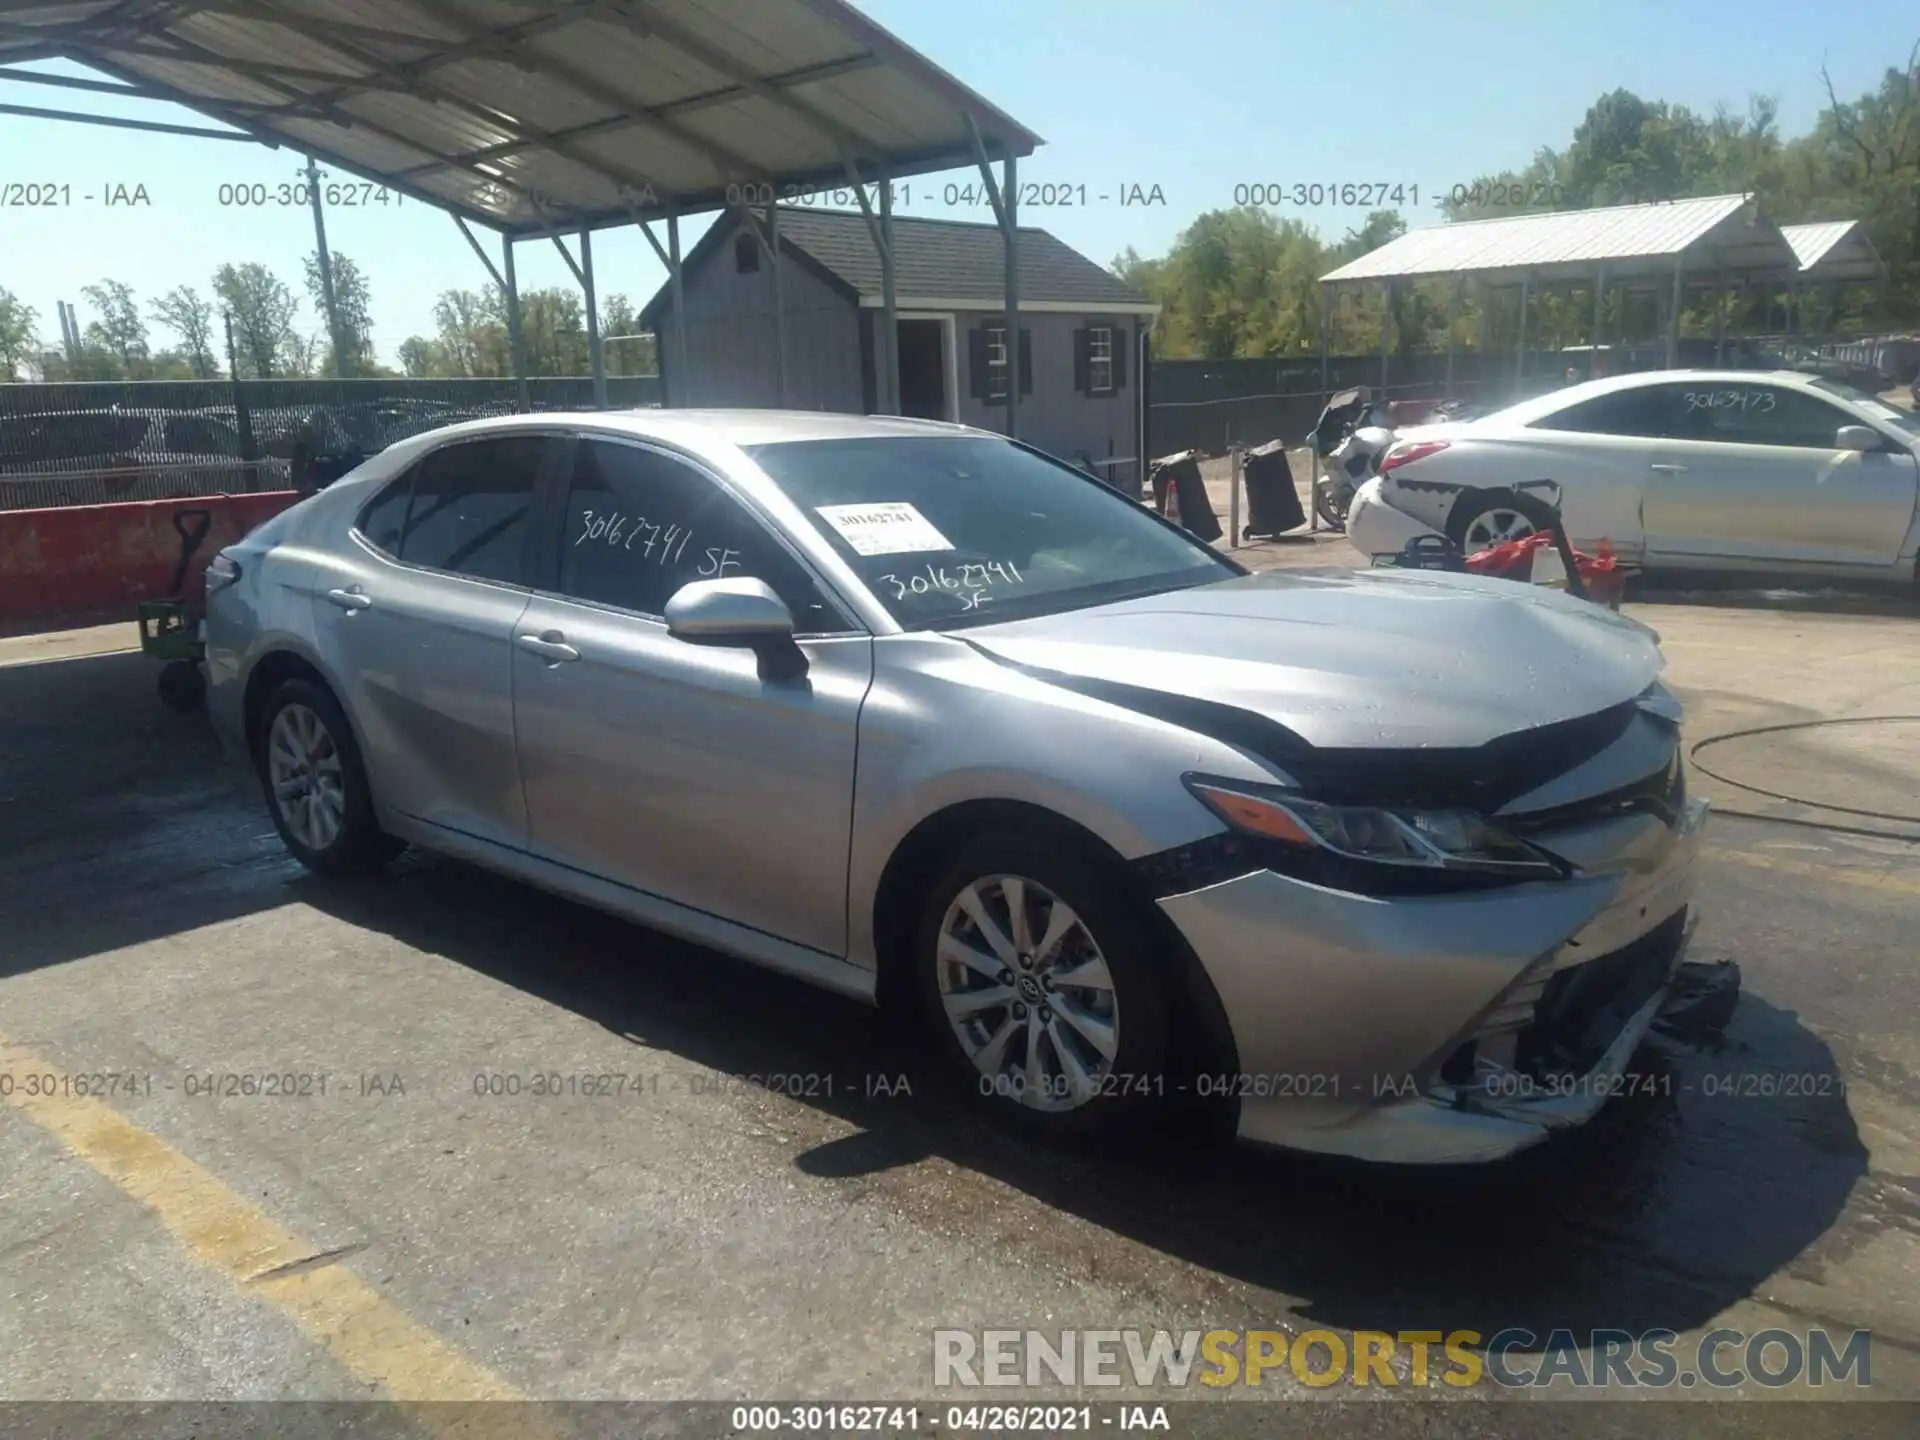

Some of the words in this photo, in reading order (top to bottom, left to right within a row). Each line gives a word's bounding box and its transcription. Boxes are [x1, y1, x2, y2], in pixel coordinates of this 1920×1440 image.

[575, 510, 692, 565] 30162741
[697, 548, 741, 579] SF
[879, 560, 1023, 600] 30162741
[956, 589, 993, 611] SF
